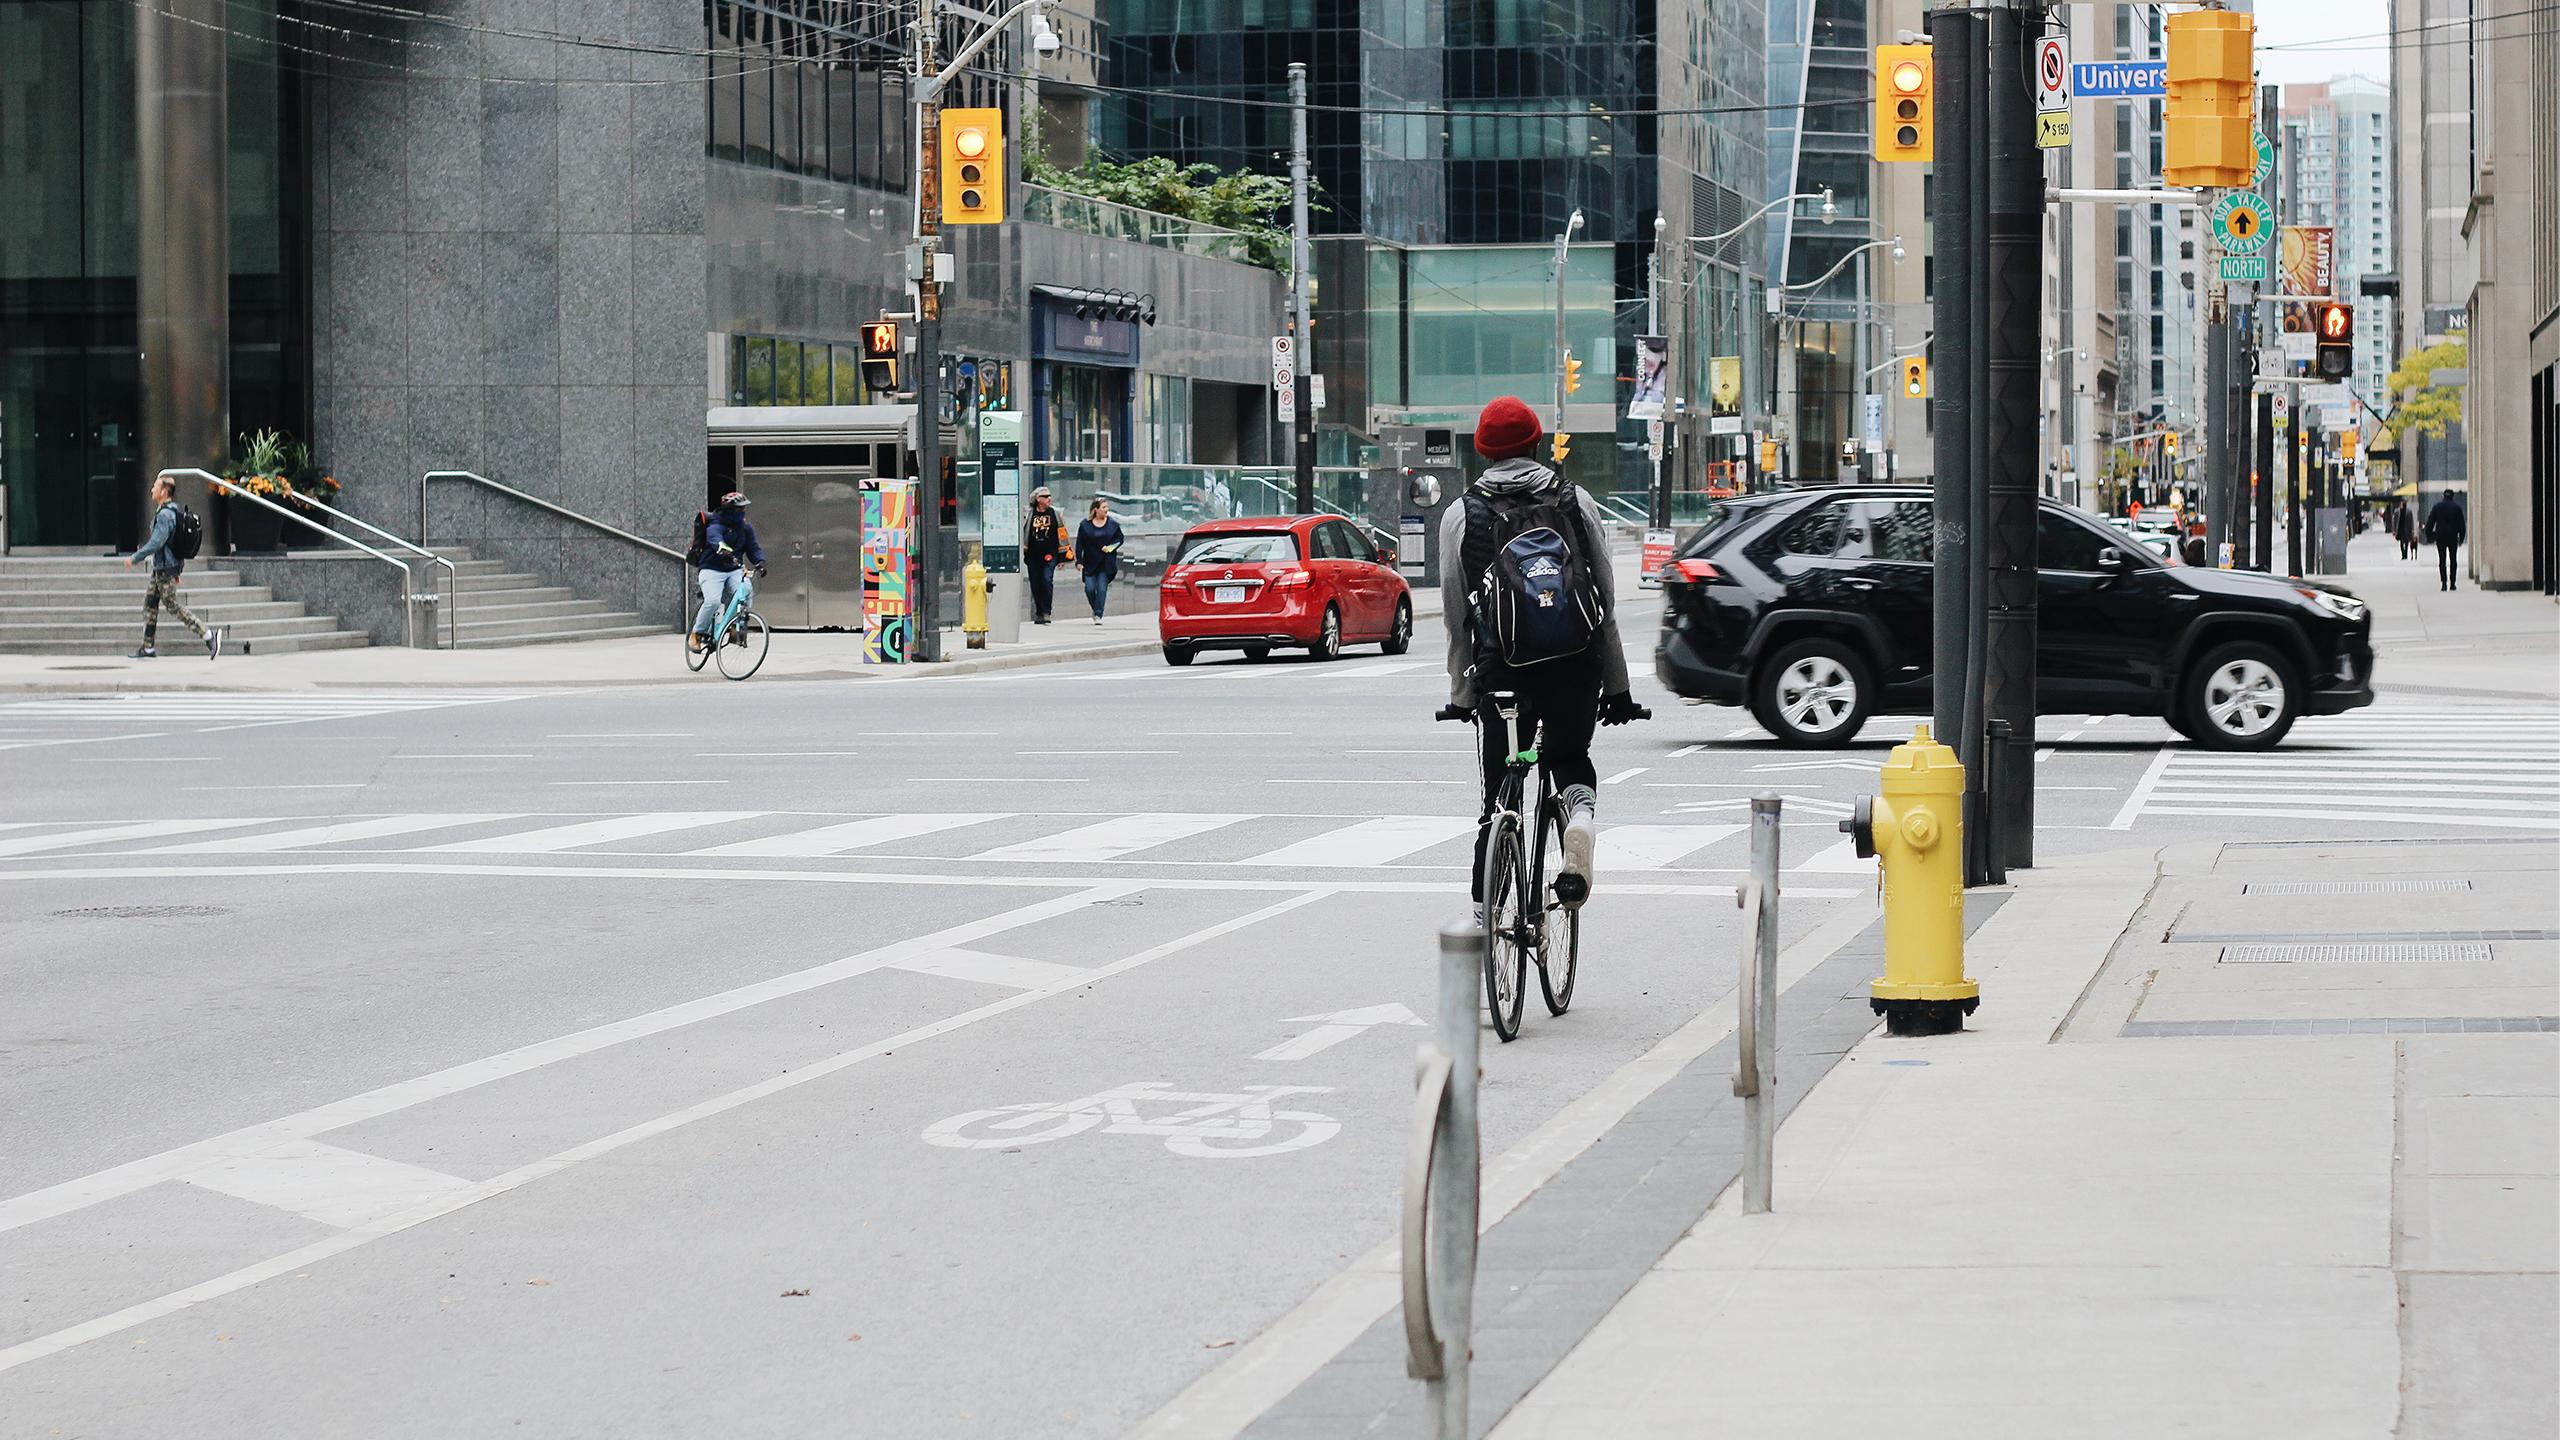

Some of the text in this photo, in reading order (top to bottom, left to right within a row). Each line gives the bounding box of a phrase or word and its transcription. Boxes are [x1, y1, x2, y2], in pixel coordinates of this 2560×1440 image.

[2214, 193, 2271, 222] DON VALLEY
[2217, 231, 2266, 253] PARKWAY
[2223, 259, 2263, 277] NORTH
[1636, 339, 1647, 381] CONNECT
[1526, 567, 1559, 578] adidas
